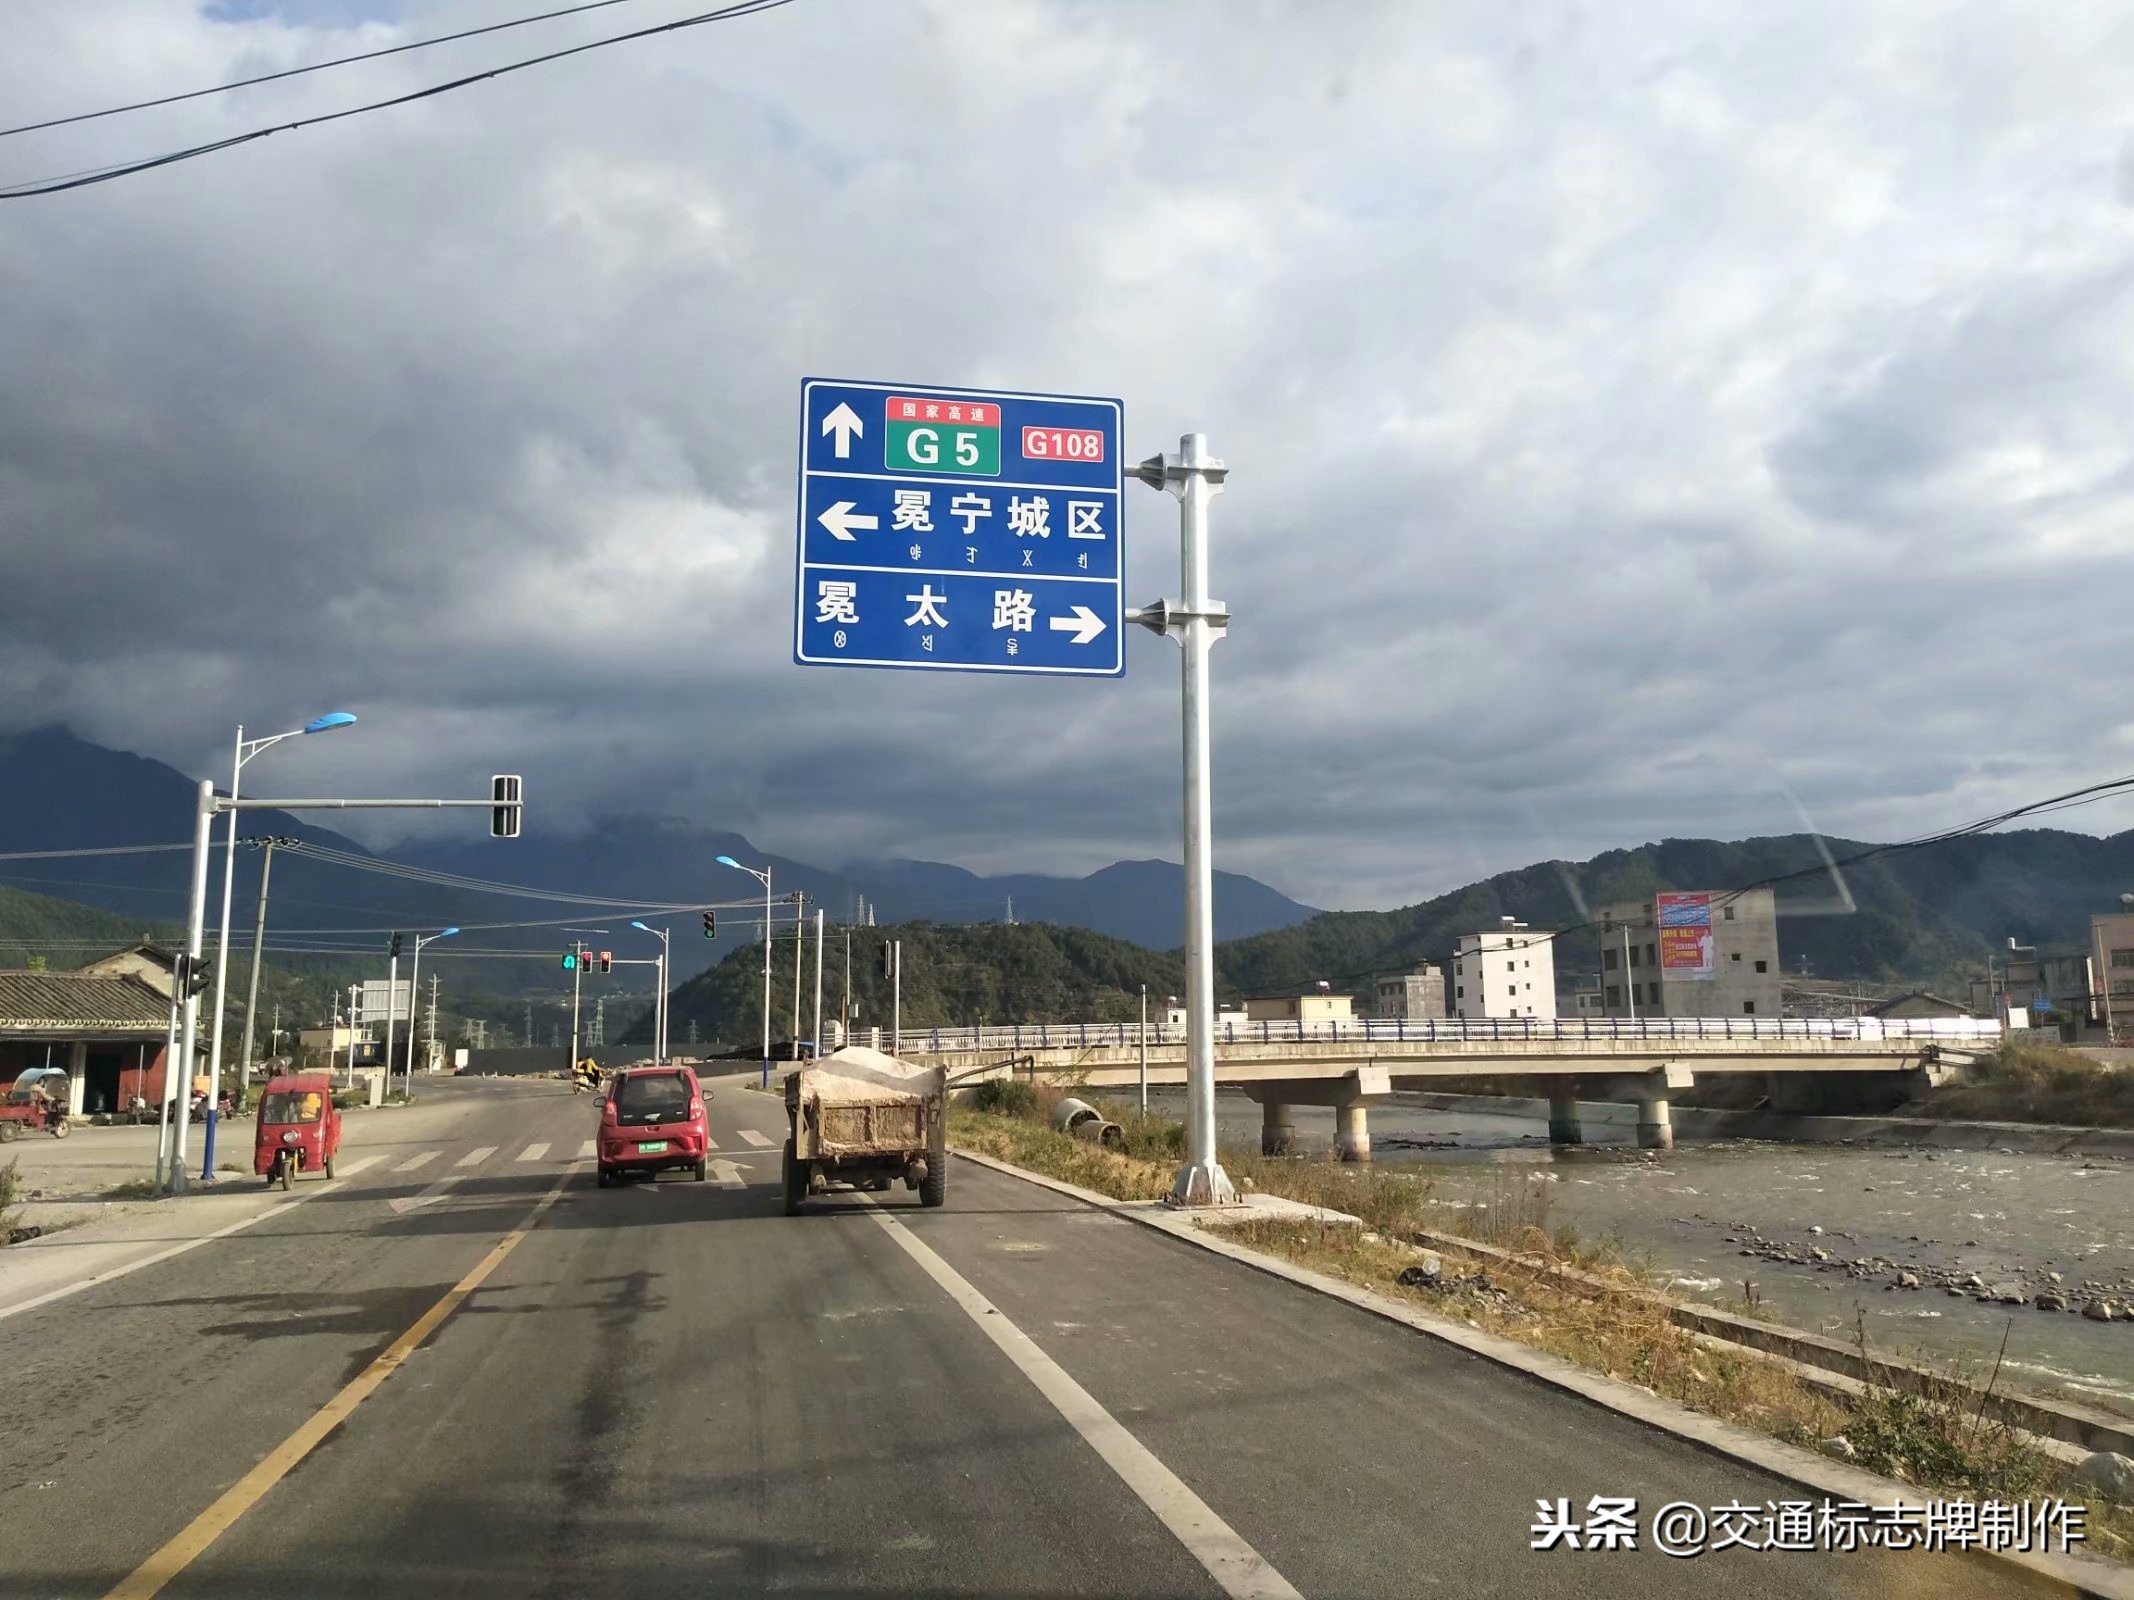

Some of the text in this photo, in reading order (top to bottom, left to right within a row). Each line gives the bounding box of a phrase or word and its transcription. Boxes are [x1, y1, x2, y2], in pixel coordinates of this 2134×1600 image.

[903, 402, 985, 422] 国家高速
[1027, 430, 1100, 458] G108
[891, 489, 1106, 540] 冕宁城区
[815, 580, 1037, 633] 冕太路
